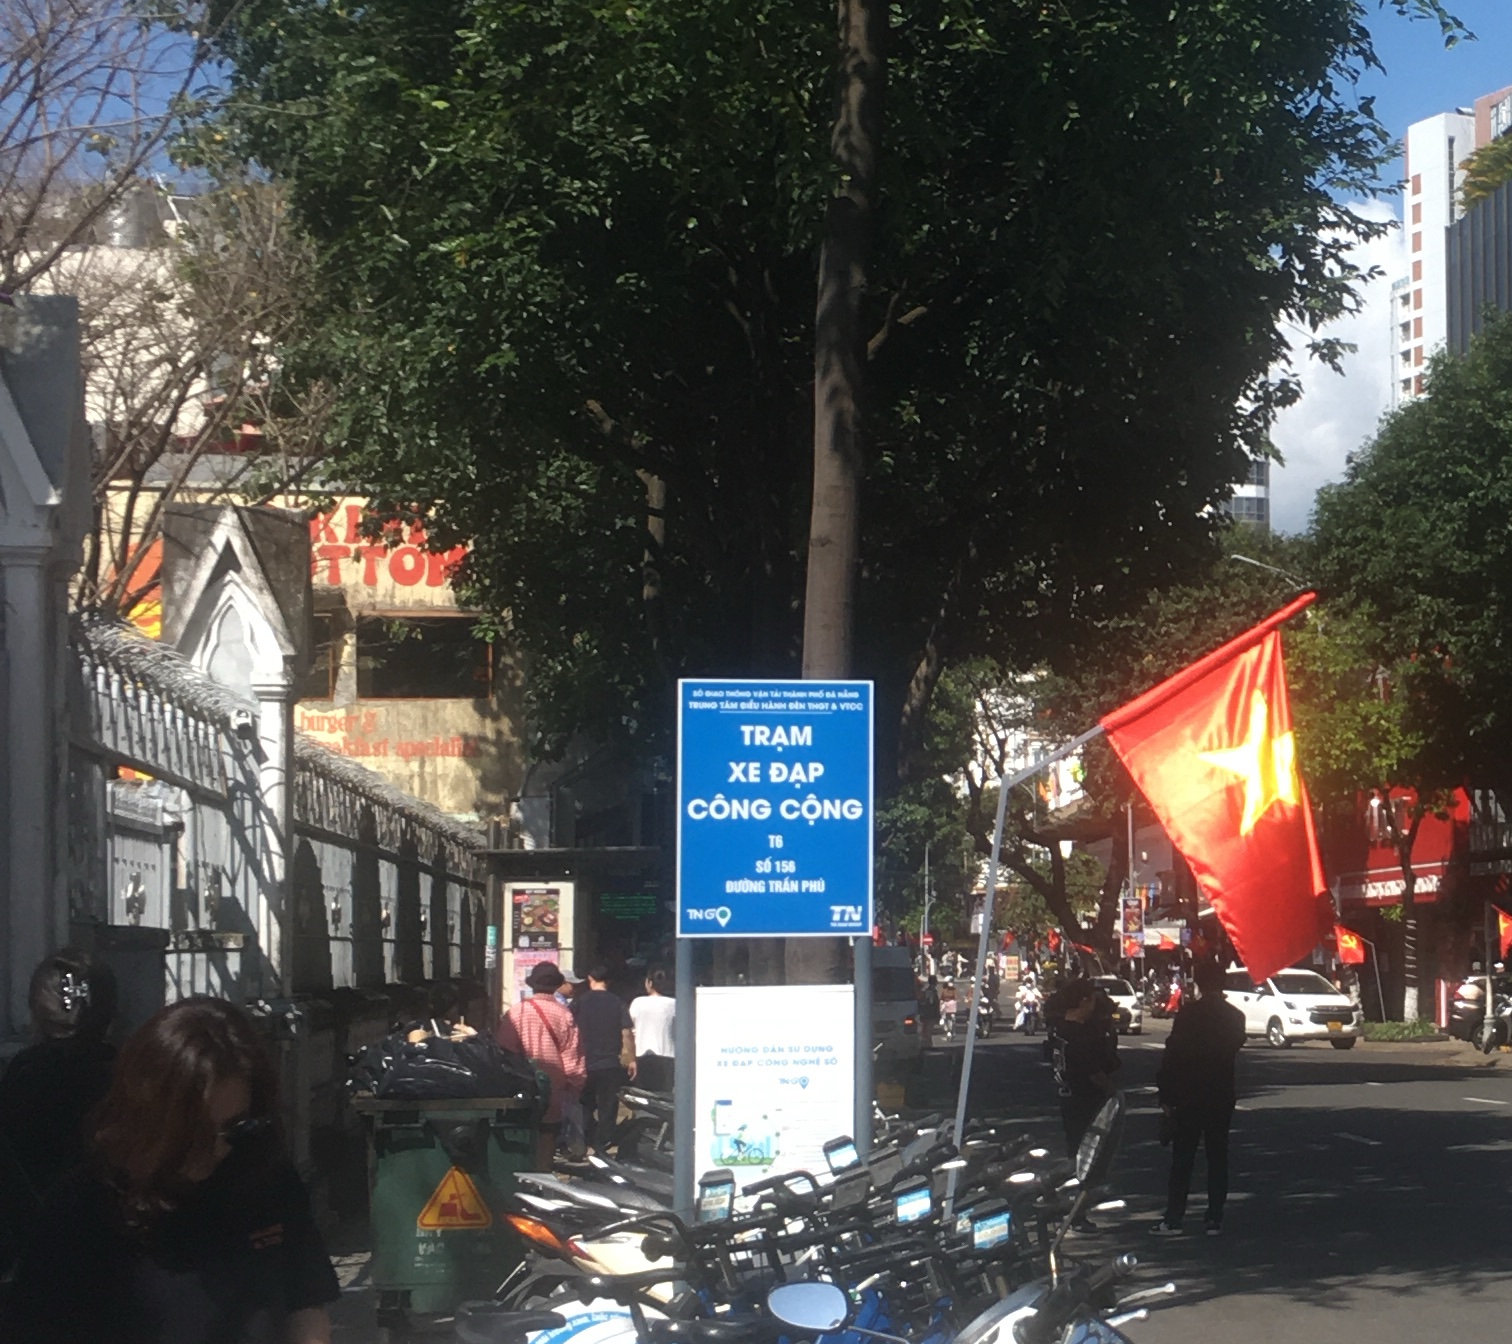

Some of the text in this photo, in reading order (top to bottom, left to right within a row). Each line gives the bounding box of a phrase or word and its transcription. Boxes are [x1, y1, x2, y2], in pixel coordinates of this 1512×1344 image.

[740, 725, 813, 752] TRẠM
[728, 762, 825, 789] XE ĐẠP
[687, 793, 863, 826] CÔNG CỘNG
[767, 834, 784, 848] T6
[755, 856, 773, 873] SỐ
[725, 877, 766, 893] ĐƯỜNG
